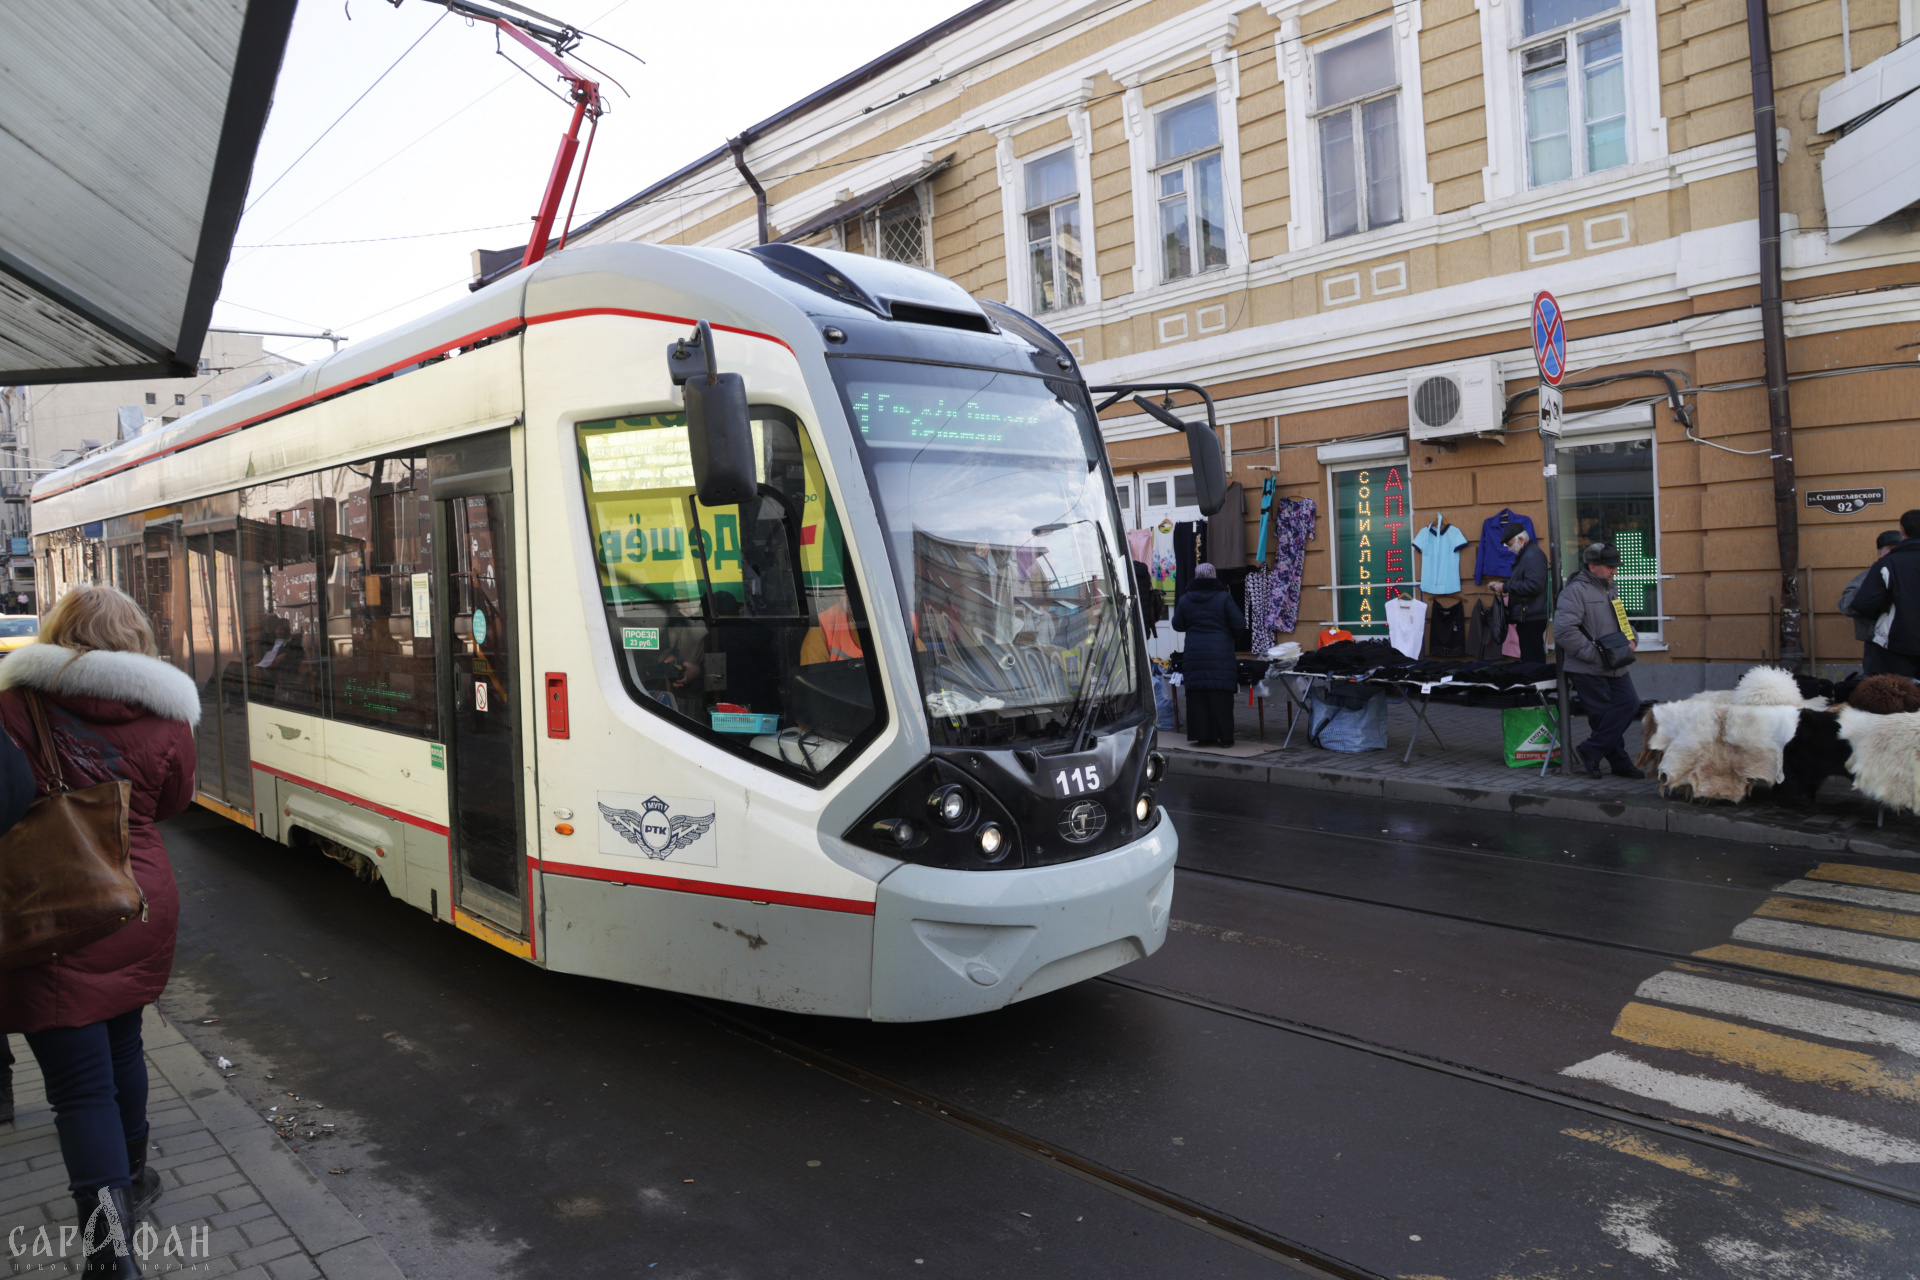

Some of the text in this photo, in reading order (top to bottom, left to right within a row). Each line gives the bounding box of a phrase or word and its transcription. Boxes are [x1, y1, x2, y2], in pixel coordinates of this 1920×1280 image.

[1837, 502, 1853, 512] 92
[1358, 471, 1371, 628] СОЦИАЛЬНАЯ
[1384, 468, 1404, 626] АПТЕК
[625, 630, 657, 640] ПРОЕЗД
[639, 639, 653, 648] руб.
[1528, 731, 1542, 744] LEROY
[1056, 765, 1100, 796] 115
[647, 801, 664, 809] МУП
[645, 825, 667, 835] РТК
